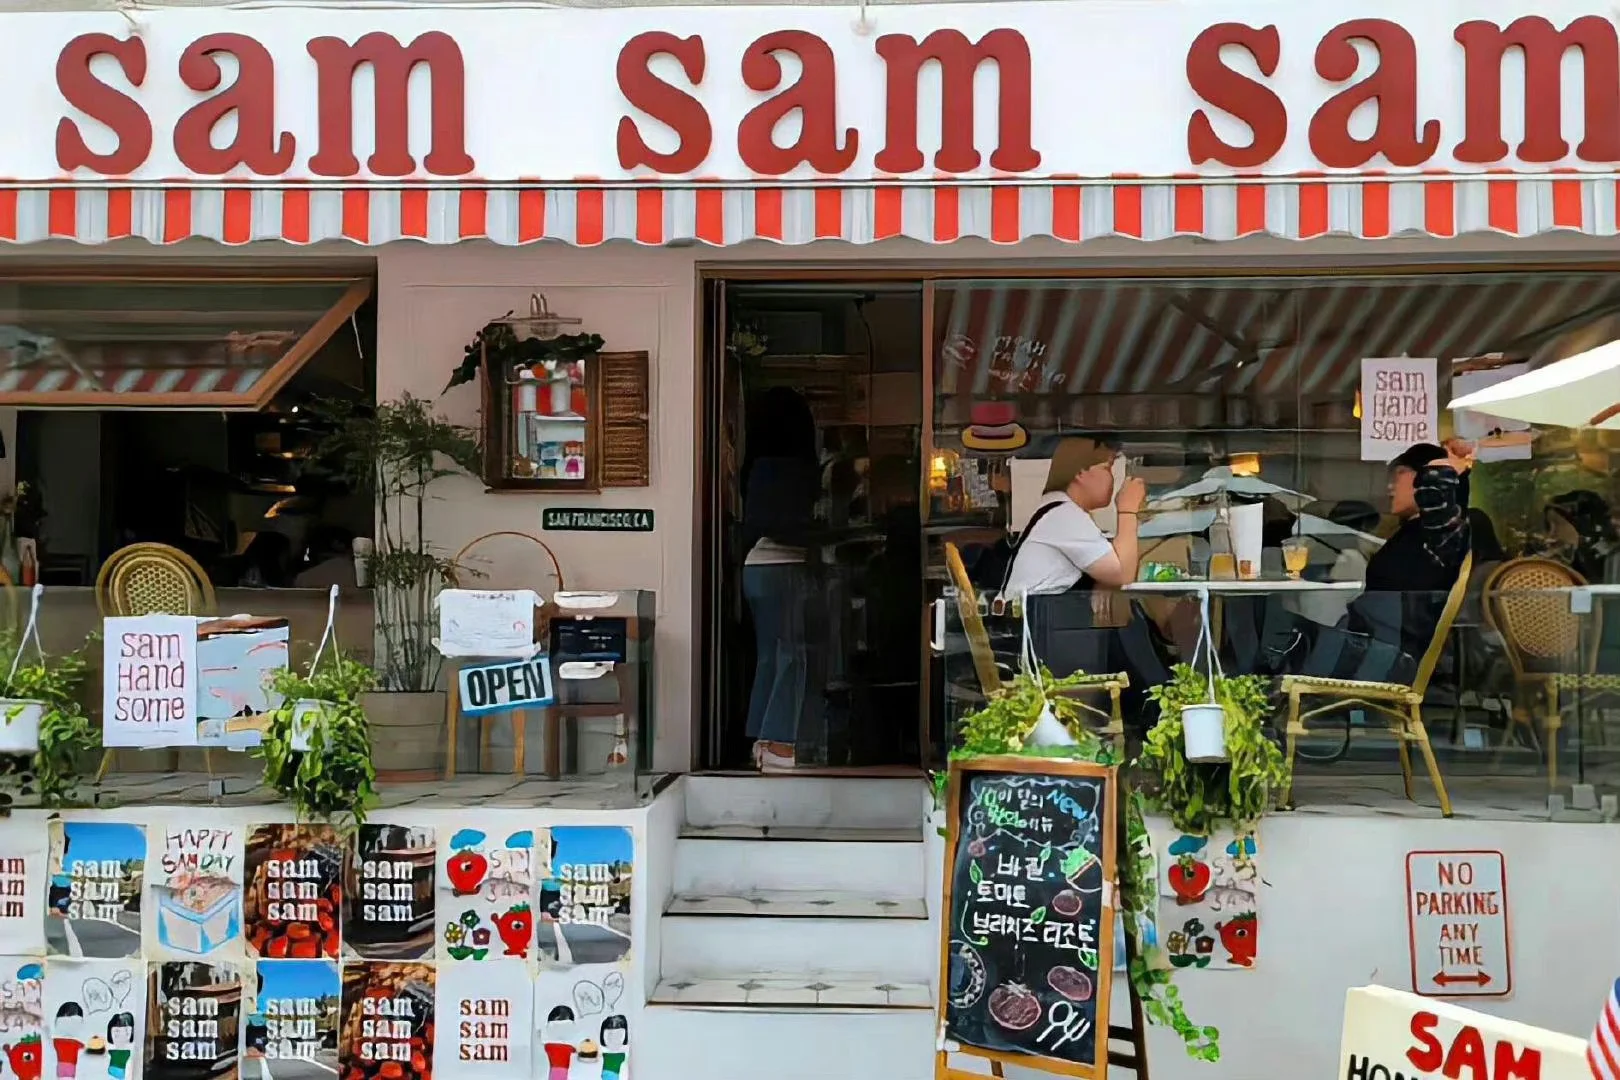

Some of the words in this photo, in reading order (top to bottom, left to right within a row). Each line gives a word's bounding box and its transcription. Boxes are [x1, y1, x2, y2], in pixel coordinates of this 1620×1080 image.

[56, 30, 475, 177] sam
[616, 28, 1041, 175] sam
[1186, 15, 1620, 168] sam
[1375, 369, 1425, 392] sam
[1373, 393, 1428, 417] Hand
[1370, 420, 1428, 441] some
[121, 633, 181, 660] sam
[118, 661, 184, 691] Hand
[467, 662, 545, 706] OPEN
[115, 696, 184, 727] some
[165, 828, 233, 850] HAPPY
[71, 859, 121, 879] sam
[267, 859, 321, 879] sam
[363, 860, 414, 879] sam
[560, 863, 609, 882] sam
[1438, 862, 1473, 887] NO
[70, 880, 120, 901] sam
[267, 882, 318, 900] sam
[363, 883, 413, 900] sam
[560, 883, 608, 905] sam
[68, 901, 122, 922] sam
[267, 902, 318, 921] sam
[363, 903, 414, 922] sam
[1416, 891, 1499, 915] PARKING
[559, 905, 609, 924] sam
[1440, 923, 1478, 943] ANY
[1440, 946, 1483, 966] TIME
[167, 997, 218, 1016] sam
[267, 998, 317, 1016] sam
[363, 997, 414, 1017] sam
[460, 998, 508, 1016] sam
[167, 1018, 218, 1038] sam
[266, 1017, 316, 1038] sam
[362, 1020, 411, 1038] sam
[459, 1021, 508, 1039] sam
[166, 1040, 217, 1060] sam
[265, 1039, 316, 1060] sam
[361, 1042, 411, 1061] sam
[459, 1043, 508, 1061] sam
[1406, 1011, 1541, 1080] SAM
